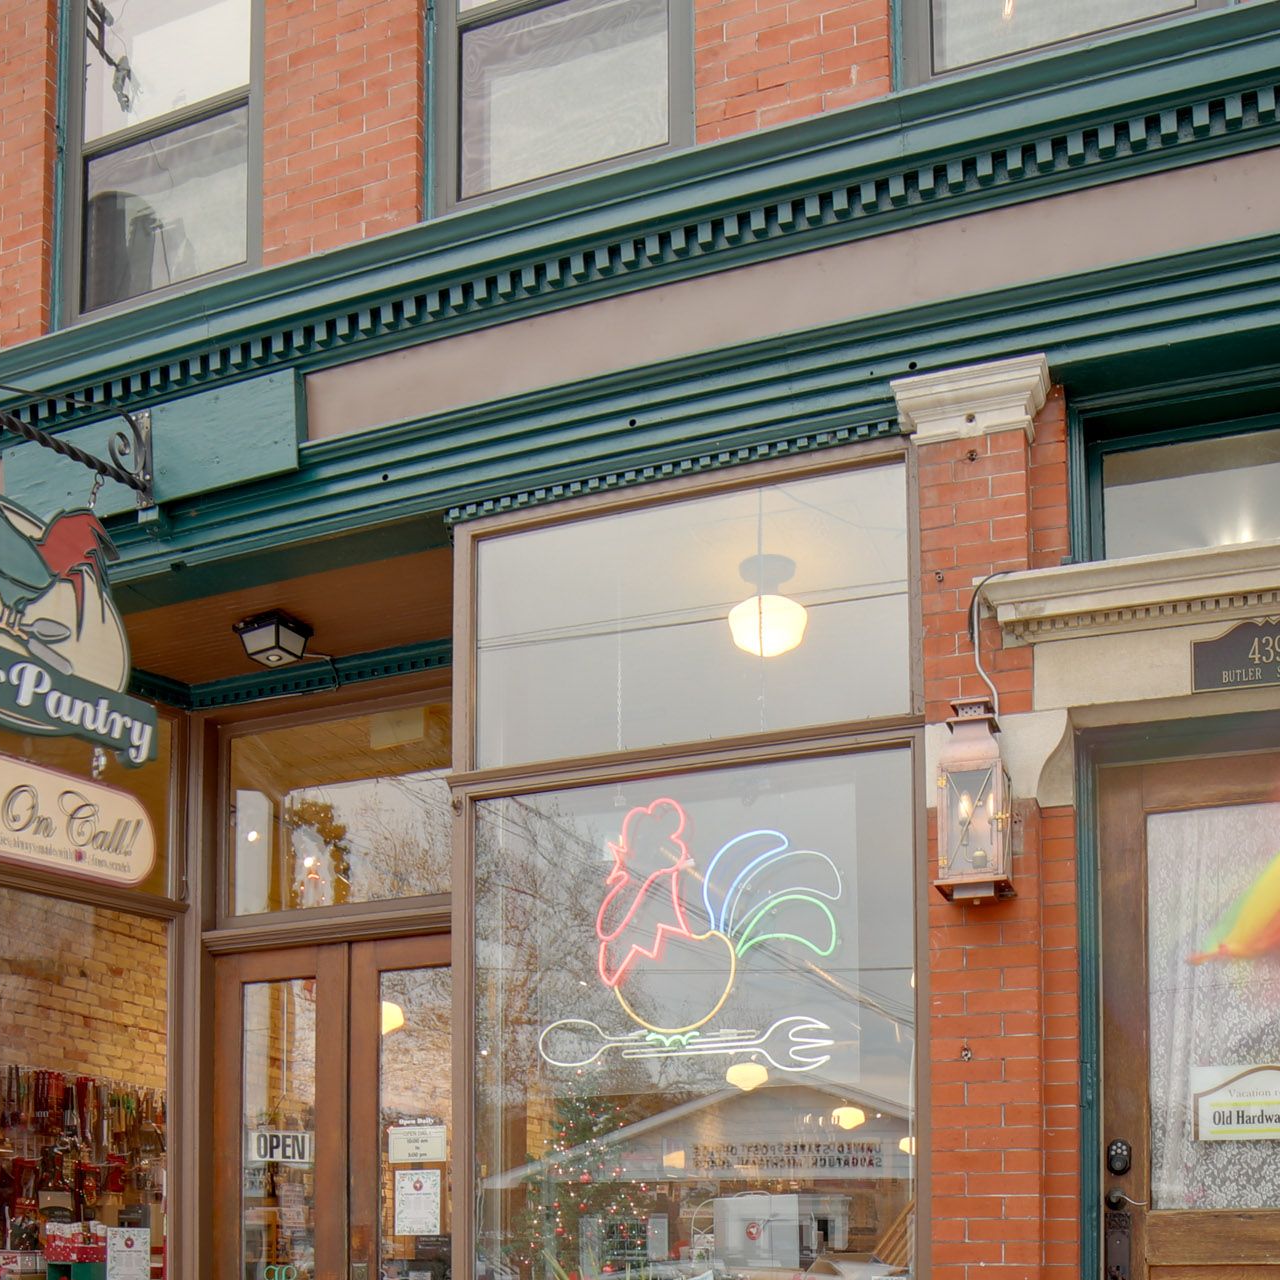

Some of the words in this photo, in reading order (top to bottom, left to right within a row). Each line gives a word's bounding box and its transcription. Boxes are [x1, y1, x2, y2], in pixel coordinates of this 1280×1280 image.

[1222, 668, 1262, 683] BUTLER
[9, 662, 153, 763] Pantry
[1, 784, 57, 838] On
[57, 790, 143, 856] Call!
[1228, 1088, 1271, 1098] Vacation
[1213, 1110, 1232, 1125] Old
[256, 1133, 306, 1160] OPEN
